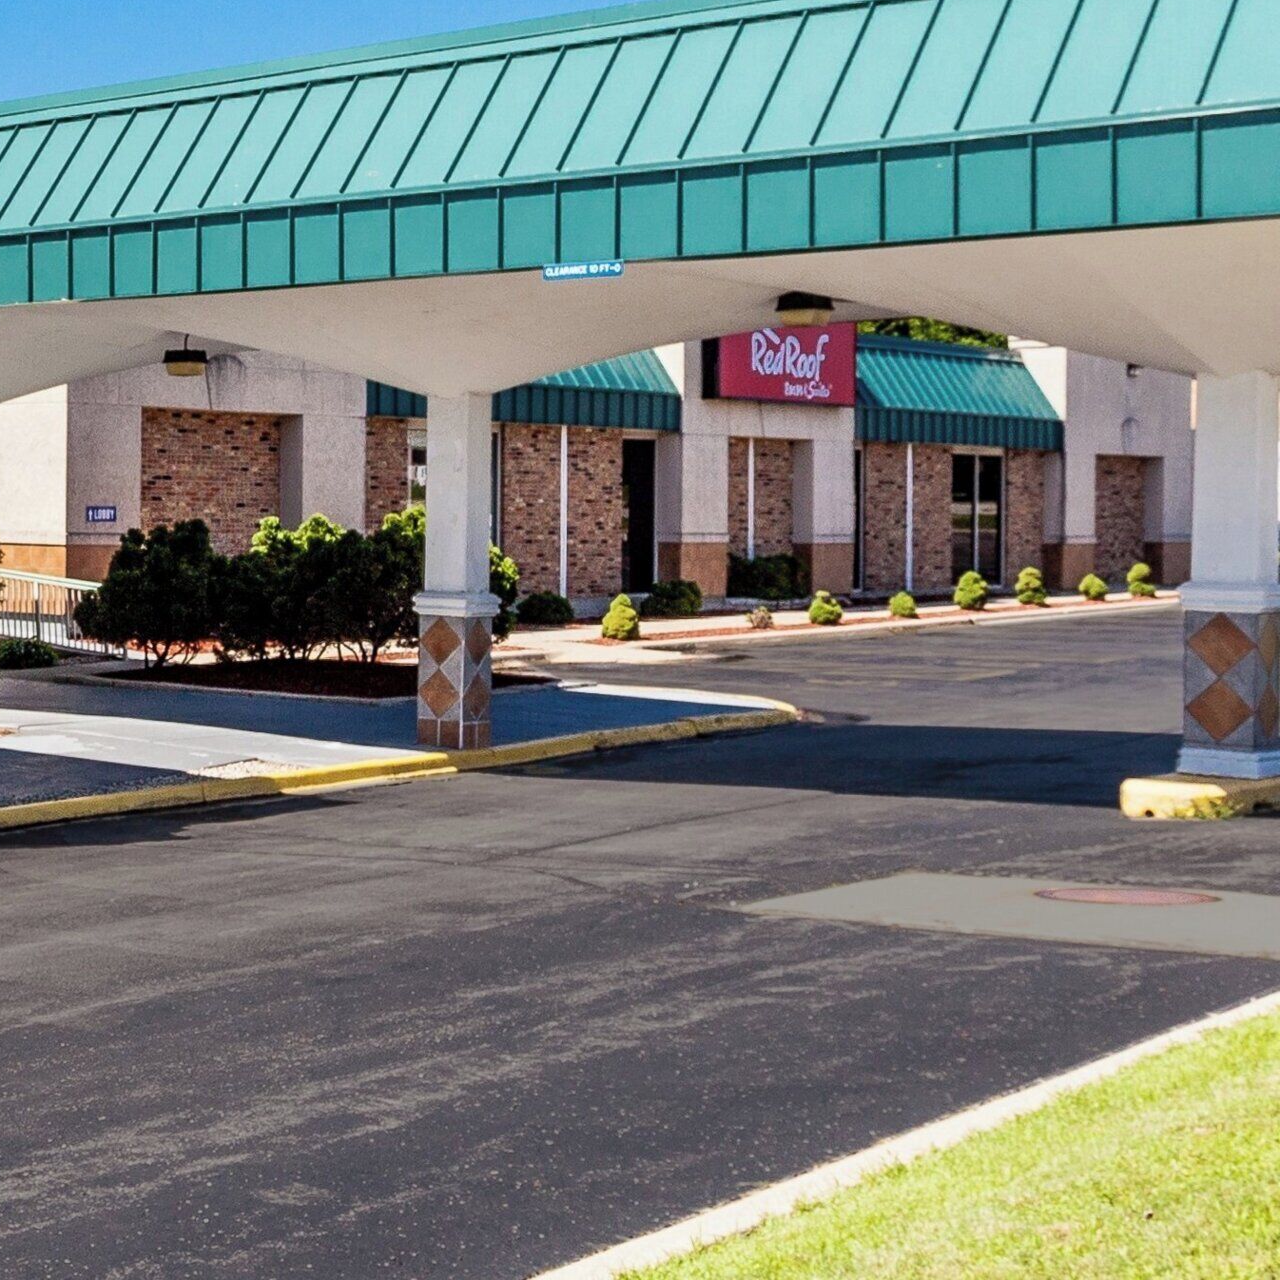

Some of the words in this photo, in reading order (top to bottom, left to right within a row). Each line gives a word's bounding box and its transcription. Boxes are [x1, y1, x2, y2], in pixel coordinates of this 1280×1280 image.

[751, 332, 785, 376] Red
[785, 334, 829, 382] Roof
[93, 509, 114, 519] LOBBY
